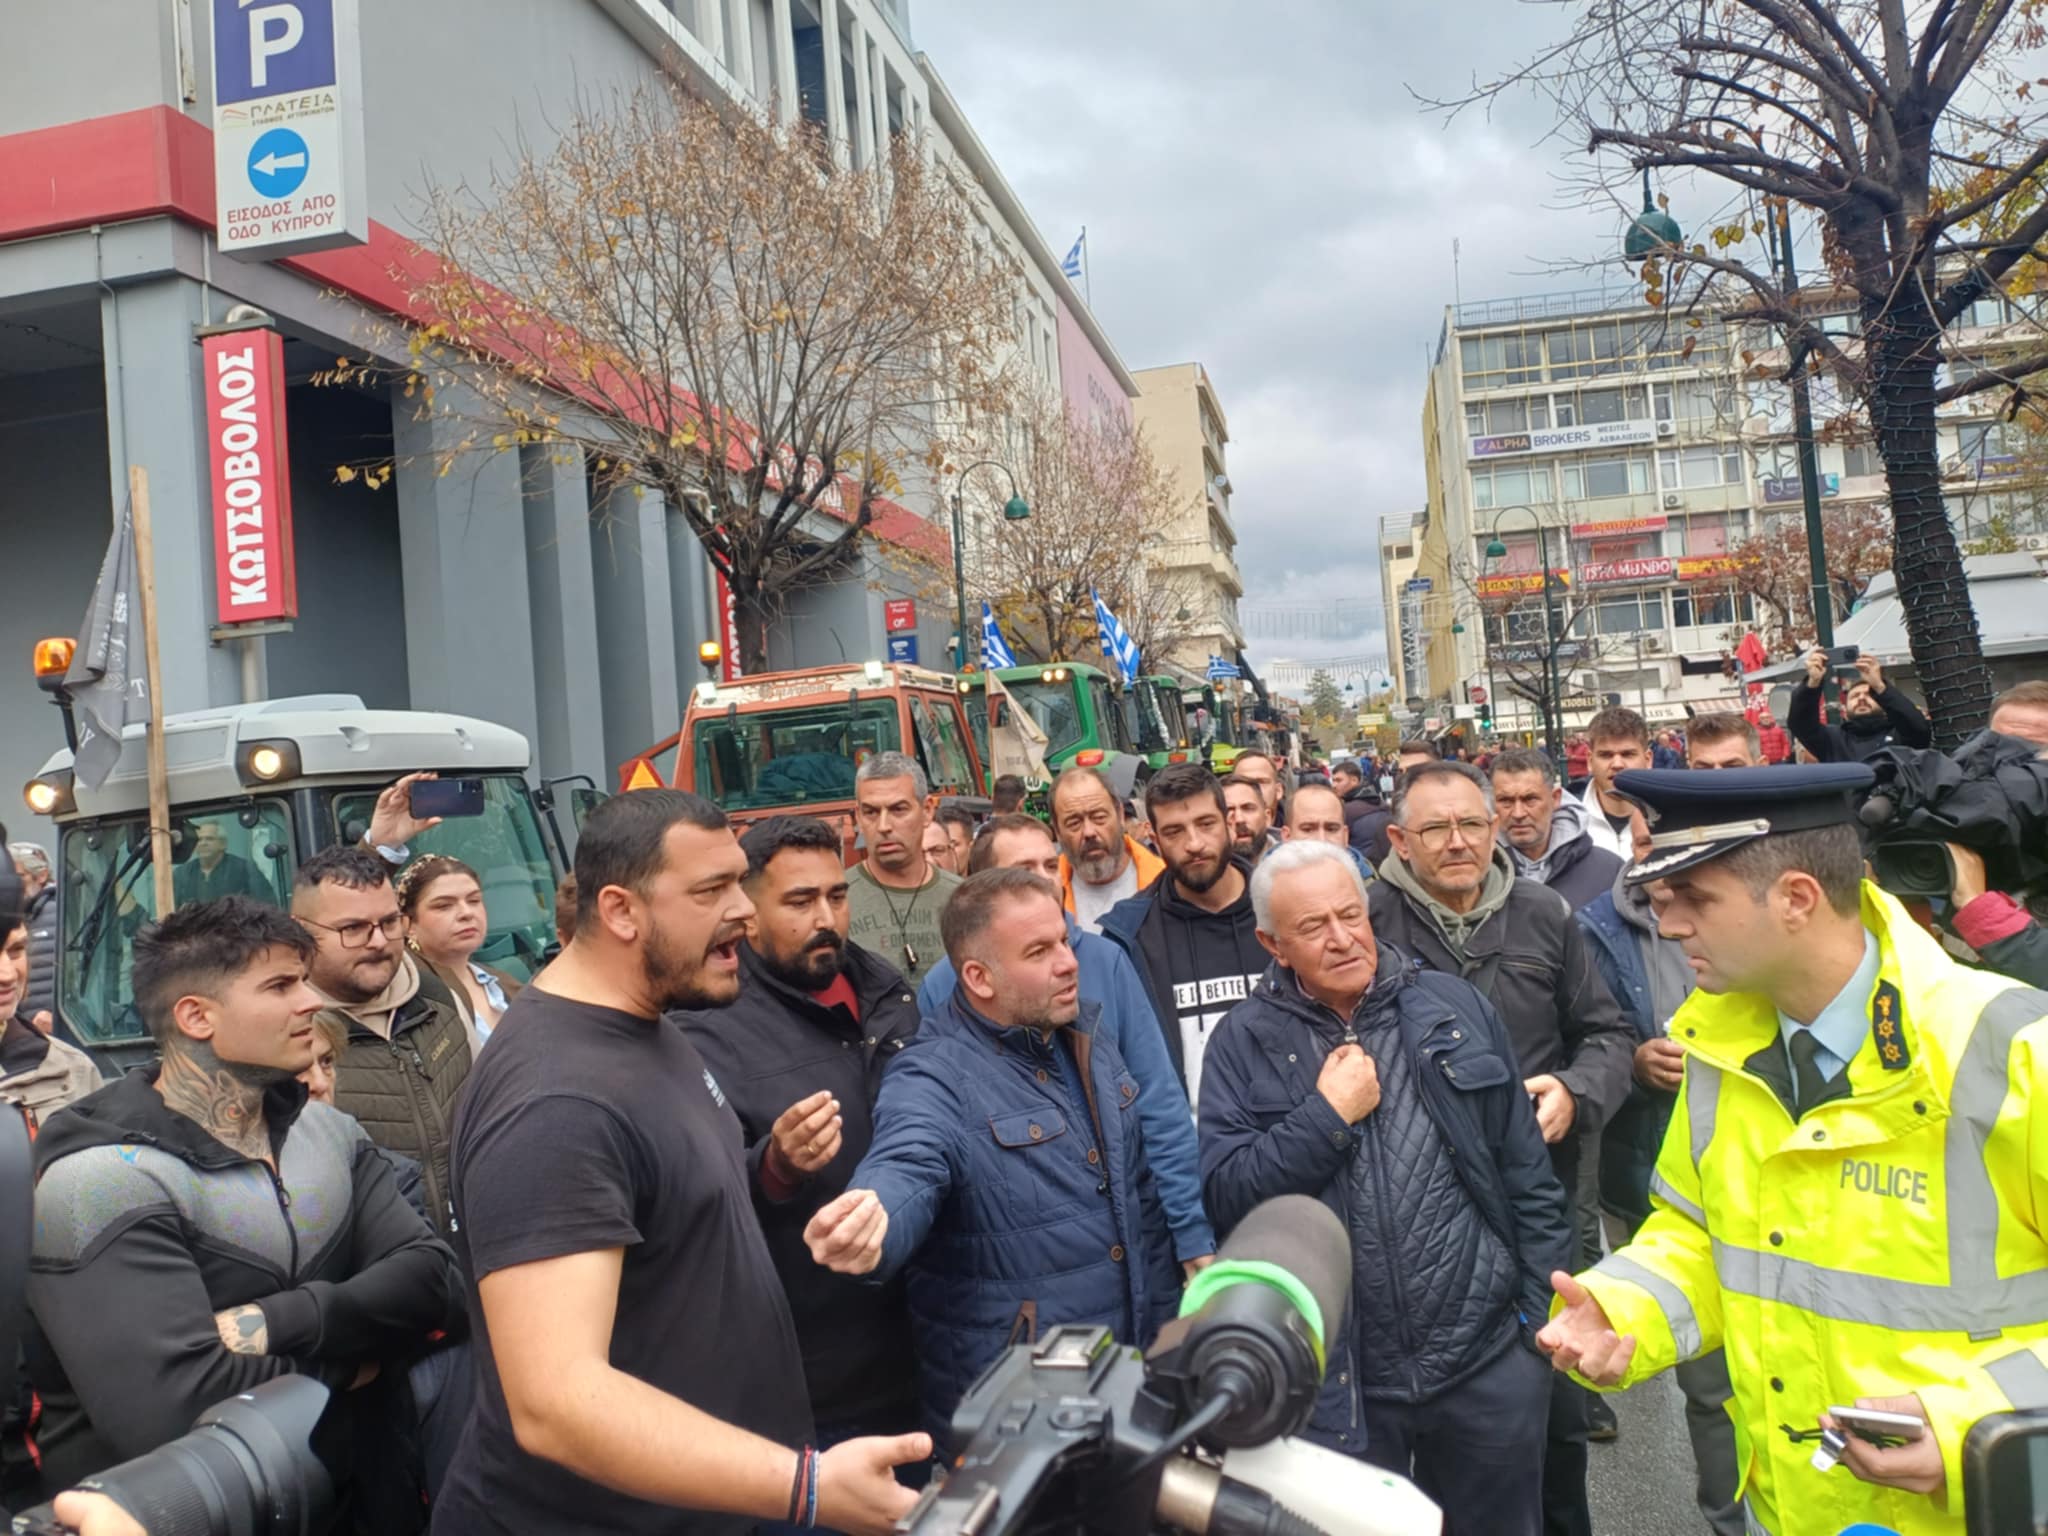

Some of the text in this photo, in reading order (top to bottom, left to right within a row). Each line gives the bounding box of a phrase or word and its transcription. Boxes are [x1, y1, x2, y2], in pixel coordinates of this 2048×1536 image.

[249, 3, 304, 88] P
[251, 94, 334, 118] ΠΛΑΤΕΙΑ
[227, 194, 336, 224] ΕΙΣΟΔΟΣ ΑΠΟ
[228, 211, 335, 240] ΟΔΟ ΚΥΠΡΟΥ
[1488, 431, 1591, 450] ALPHA BROKERS
[217, 347, 268, 605] ΚΩΤΣΟΒΟΛΟΣ
[1206, 979, 1243, 1000] BETTE
[1840, 1158, 1928, 1205] POLICE
